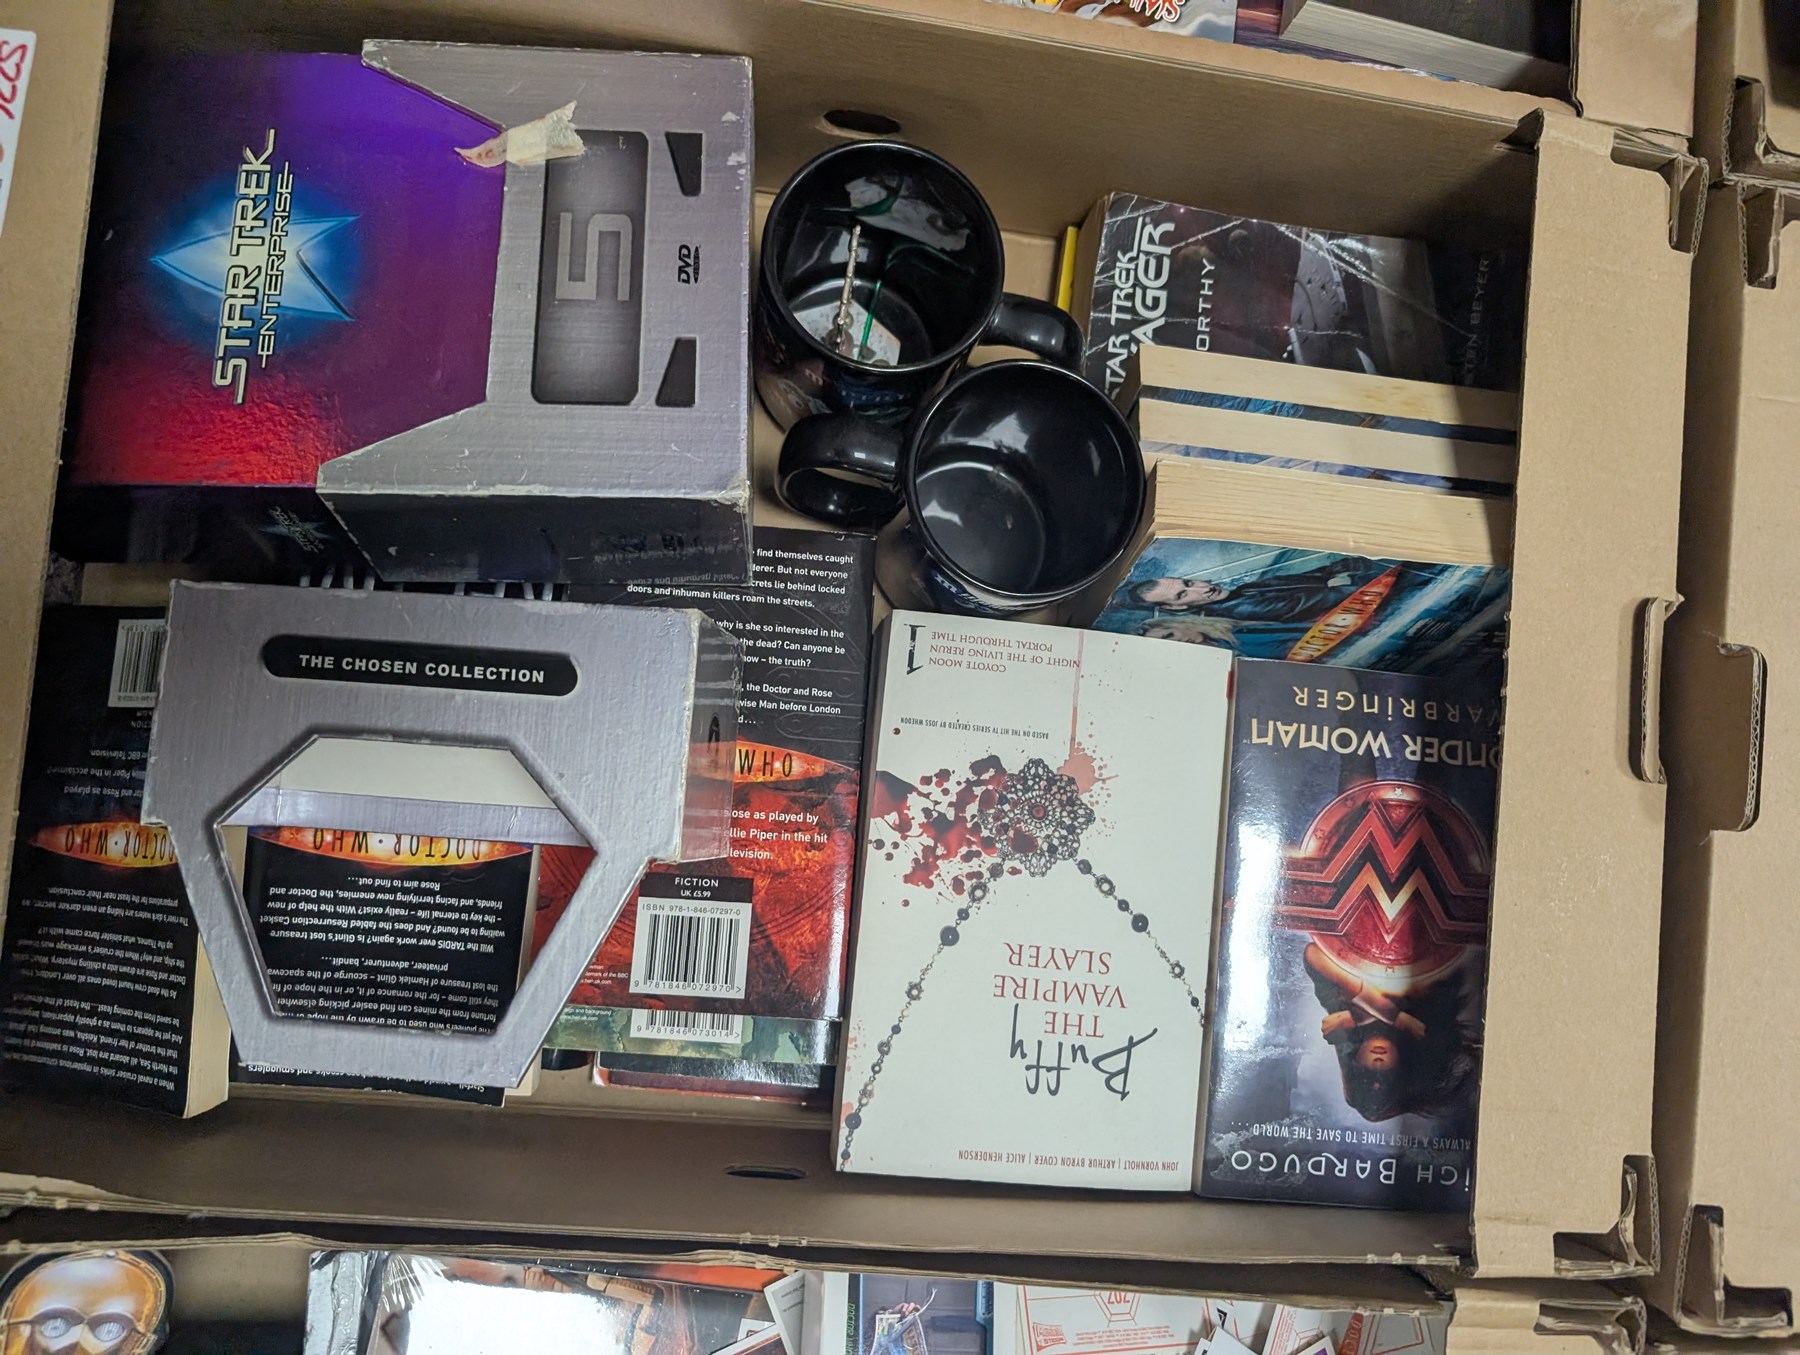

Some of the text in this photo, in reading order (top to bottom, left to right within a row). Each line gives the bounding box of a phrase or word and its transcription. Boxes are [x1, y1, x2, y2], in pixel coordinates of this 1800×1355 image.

[214, 129, 276, 404] STAR TREK
[257, 161, 294, 369] ENTERPRISE
[677, 244, 692, 285] DVD
[1110, 217, 1143, 326] TREK
[757, 549, 853, 564] find themselves caught
[777, 566, 848, 580] But not everyone
[774, 580, 846, 594] lie behind locked
[627, 584, 815, 608] doors and inhuman killers roam the streets.
[1338, 589, 1385, 616] WHO
[716, 620, 734, 630] why
[735, 620, 744, 630] is
[745, 621, 761, 631] she
[775, 624, 819, 636] interested
[820, 627, 829, 636] in
[830, 628, 845, 638] the
[756, 638, 846, 654] dead? Can anyone be
[931, 631, 1053, 652] PORTAL THROUGH TIME
[768, 656, 811, 667] the truth?
[929, 644, 1081, 668] NIGHT OF THE LIVING RERUN
[299, 654, 545, 683] THE CHOSEN COLLECTION
[928, 656, 1006, 673] COYOTE MOON
[746, 683, 833, 698] the Doctor and Rose
[759, 700, 841, 715] Man before London
[900, 717, 1049, 739] BASED ON THE HIT TV SERIES CREATED BY JOSS WHEDON
[1251, 718, 1392, 758] WOMAN
[738, 748, 793, 777] WHO
[90, 768, 103, 776] the
[64, 785, 90, 795] played
[102, 787, 120, 797] Rose
[753, 811, 819, 824] as played by
[312, 829, 370, 854] WHO
[749, 830, 828, 843] Piper in the hit
[65, 828, 174, 862] DOCTOR WHO
[674, 877, 719, 888] FICTION
[642, 903, 741, 916] ISBN 978-1-846-07297-0
[260, 915, 505, 938] waiting to be found? And does the fabled Resurrection Casket
[270, 930, 308, 940] treasure
[310, 932, 326, 941] lost
[327, 933, 355, 943] Glint's
[357, 934, 365, 943] Is
[366, 934, 395, 944] again?
[396, 937, 417, 945] work
[438, 940, 465, 951] TARDIS
[466, 942, 479, 951] the
[480, 944, 494, 953] Will
[1003, 942, 1112, 975] SLAYER
[634, 979, 639, 988] 9
[993, 974, 1127, 1009] VAMPIRE
[1044, 1011, 1105, 1039] THE
[1010, 1003, 1158, 1101] Buffy
[1293, 1126, 1314, 1139] THE
[1316, 1128, 1342, 1142] SAVE
[1345, 1131, 1358, 1142] TO
[1362, 1134, 1385, 1145] TIME
[1389, 1134, 1420, 1148] FIRST
[958, 1150, 1179, 1171] JOHN VORNHOLT ARTHUR BYRON COVER ALICE HENDERSON
